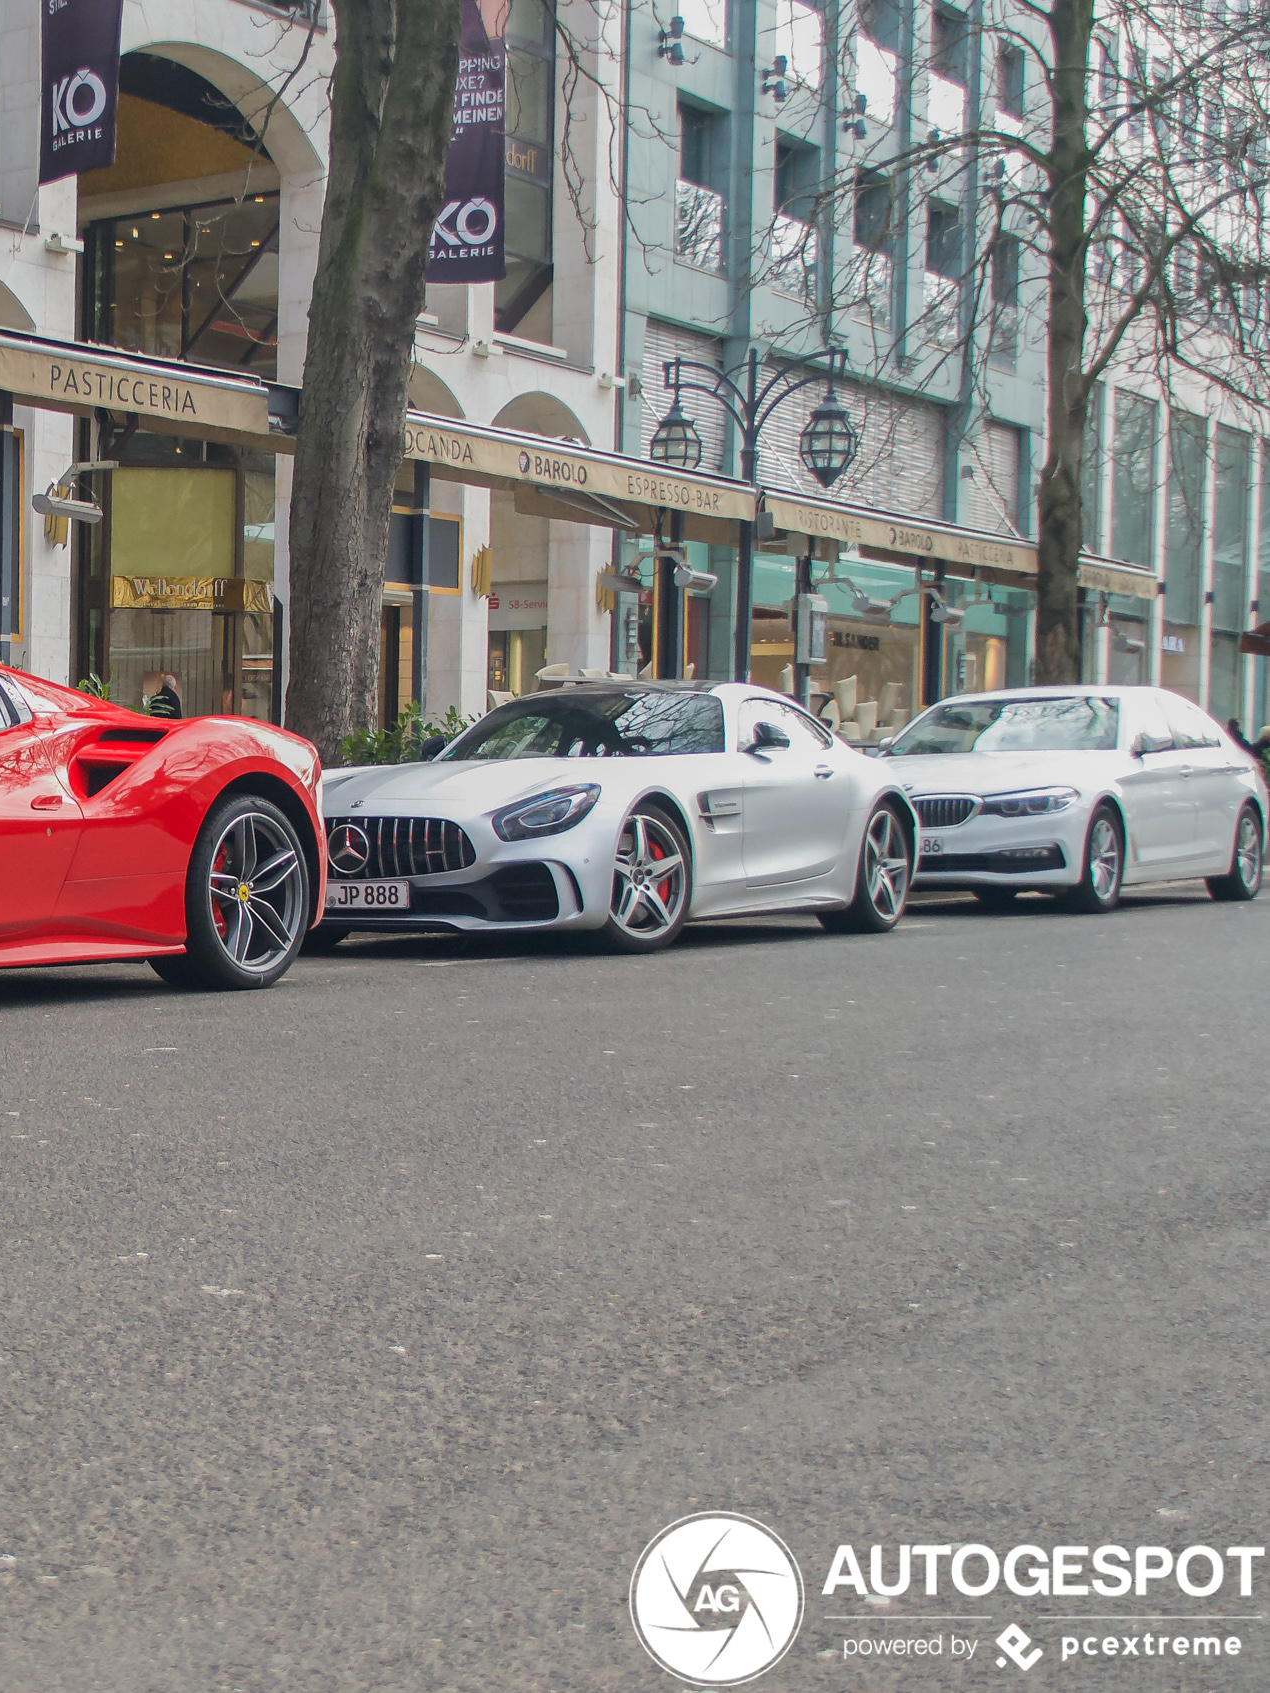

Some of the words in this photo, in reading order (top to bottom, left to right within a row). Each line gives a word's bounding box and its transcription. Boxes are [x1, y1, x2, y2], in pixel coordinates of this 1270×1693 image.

[52, 128, 103, 152] GALERIE
[50, 364, 197, 415] PASTICCERIA
[534, 455, 587, 485] BAROLO
[627, 475, 720, 511] ESPRESSO-BAR
[797, 508, 862, 539] RISTORANTE
[898, 529, 933, 552] BAROLO
[132, 578, 228, 598] Wellendorff
[337, 885, 360, 905] JP
[364, 885, 399, 905] 888
